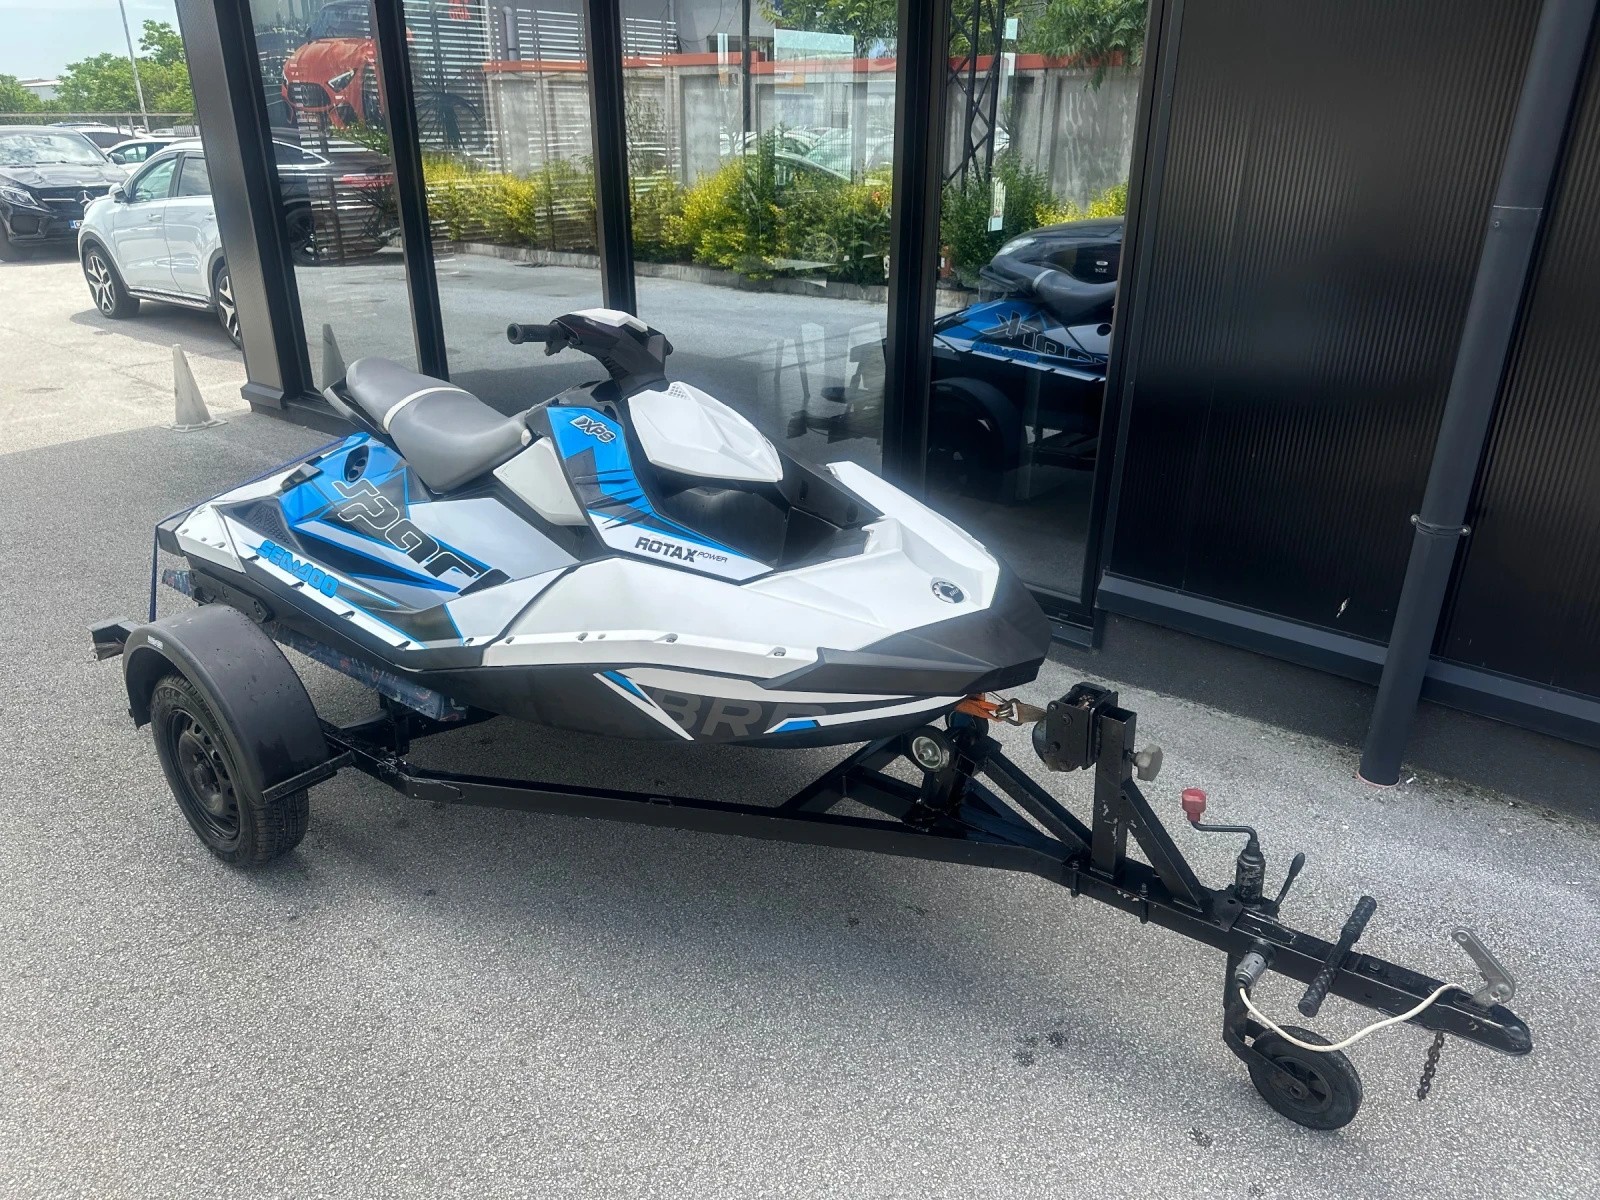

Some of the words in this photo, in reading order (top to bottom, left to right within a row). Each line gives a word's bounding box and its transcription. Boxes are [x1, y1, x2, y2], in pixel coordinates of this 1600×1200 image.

[572, 416, 616, 443] XPS
[635, 537, 697, 563] ROTAX
[696, 551, 728, 564] POWER
